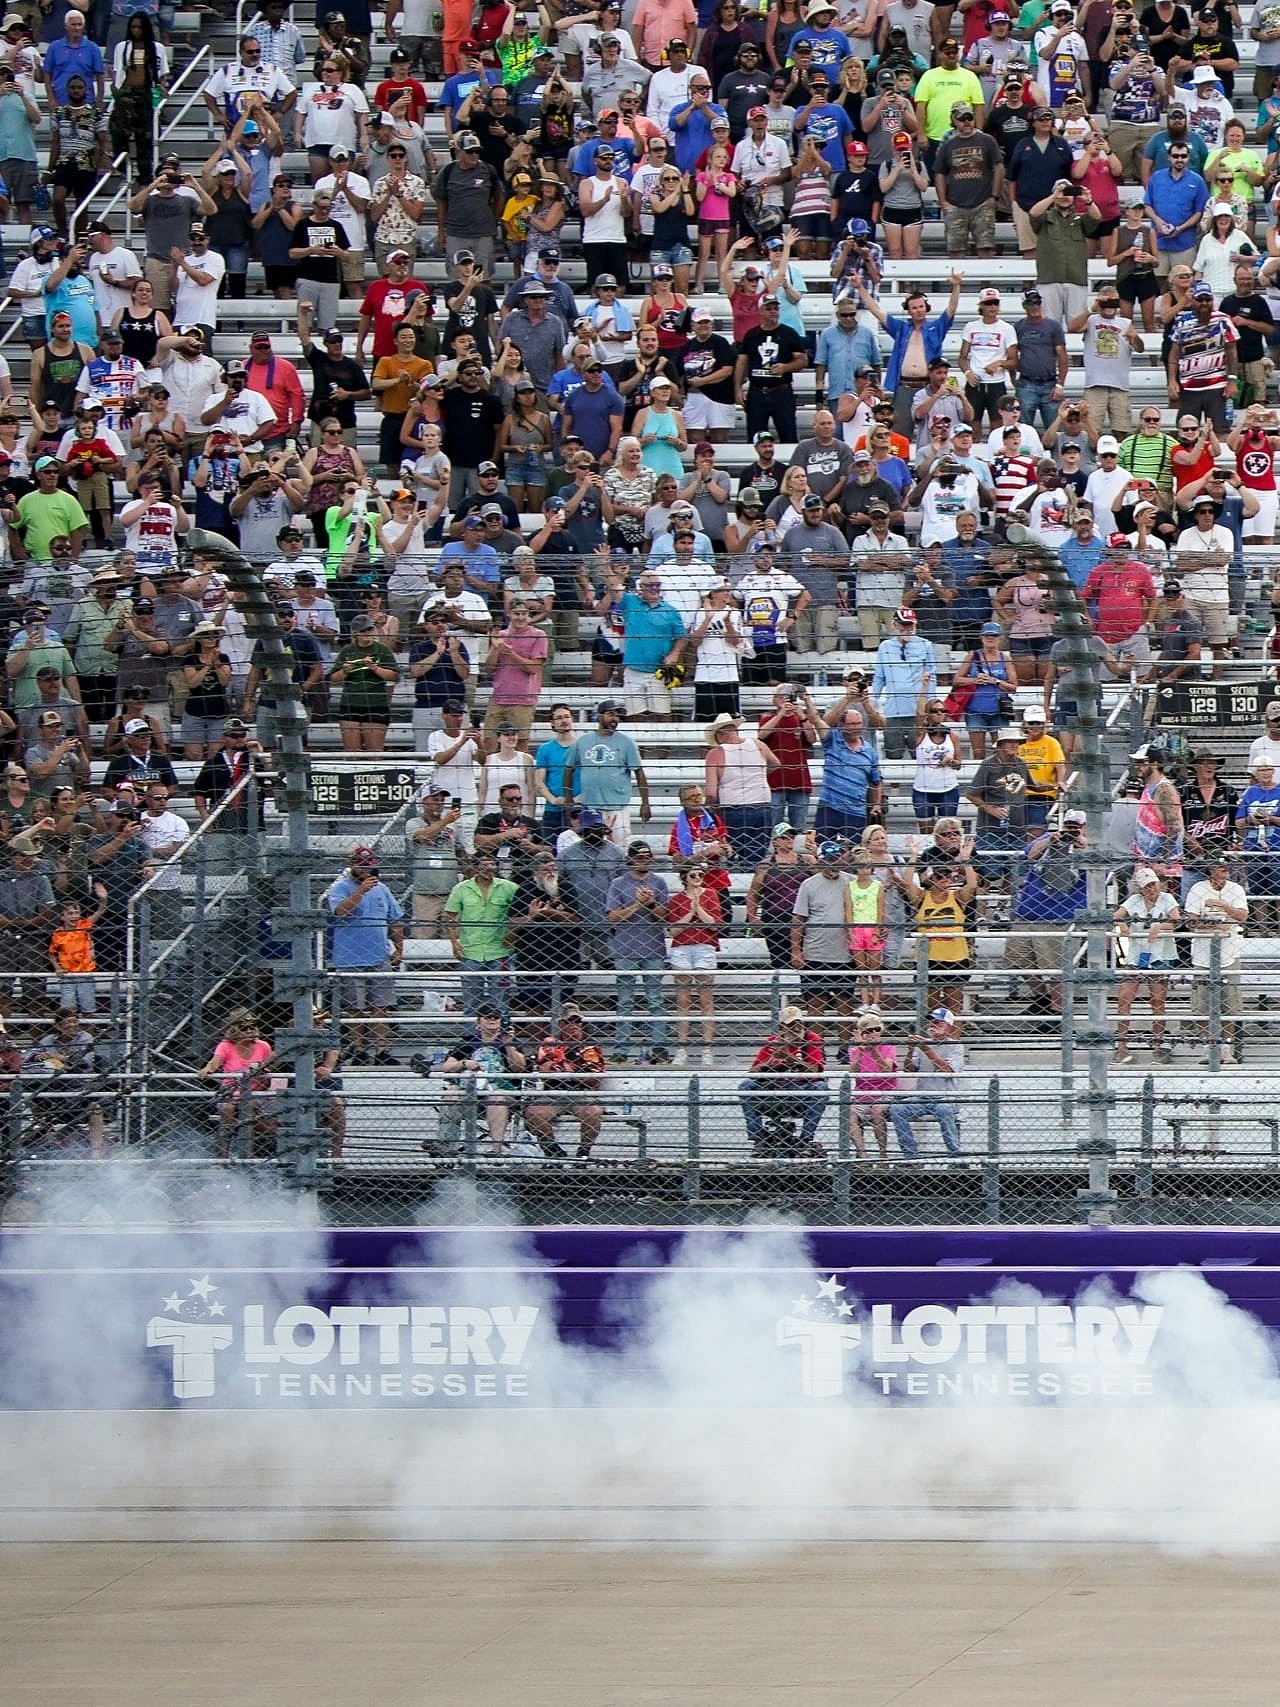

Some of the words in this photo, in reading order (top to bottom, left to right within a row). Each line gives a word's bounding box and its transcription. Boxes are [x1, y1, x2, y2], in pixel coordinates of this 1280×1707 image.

[1188, 687, 1217, 697] SECTION
[1231, 686, 1258, 696] SECTION
[1190, 698, 1217, 713] 129
[1231, 697, 1258, 712] 130
[311, 775, 339, 785] SECTION
[353, 774, 386, 785] SECTIONS
[313, 786, 339, 801] 129
[354, 785, 413, 801] 129-130
[244, 1304, 539, 1366] LOTTERY
[872, 1304, 1164, 1365] LOTTERY
[246, 1373, 529, 1397] TENNESSEE
[874, 1372, 1154, 1396] TENNESSEE
